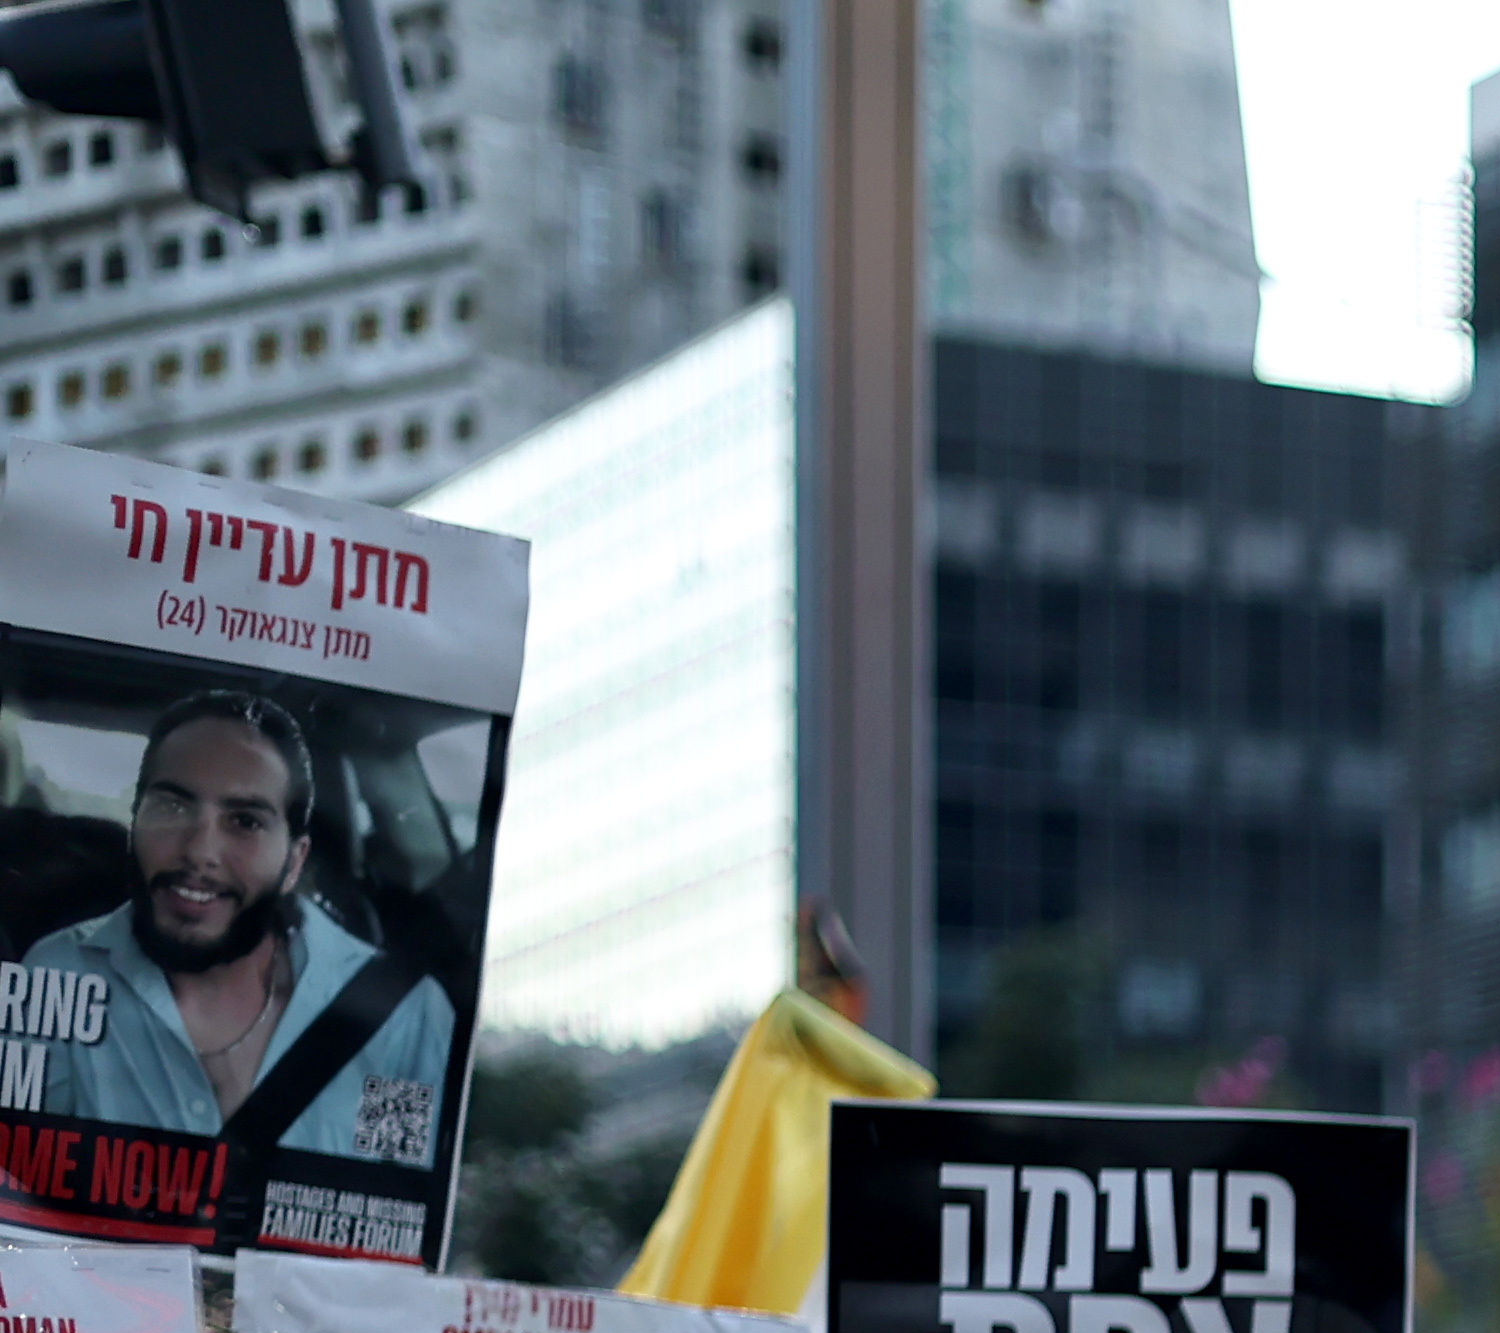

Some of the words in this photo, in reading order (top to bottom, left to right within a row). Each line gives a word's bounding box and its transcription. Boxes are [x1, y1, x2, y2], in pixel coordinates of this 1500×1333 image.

[110, 494, 168, 563] חי
[182, 508, 316, 587] עדיין
[330, 536, 430, 614] מתן
[157, 590, 205, 635] (24)
[215, 605, 316, 649] צנגאוקר
[323, 624, 371, 661] מתן
[90, 1135, 228, 1219] NOW!
[261, 1203, 351, 1247] FAMILIES
[352, 1217, 423, 1257] FORUM
[939, 1162, 1296, 1296] פעימה
